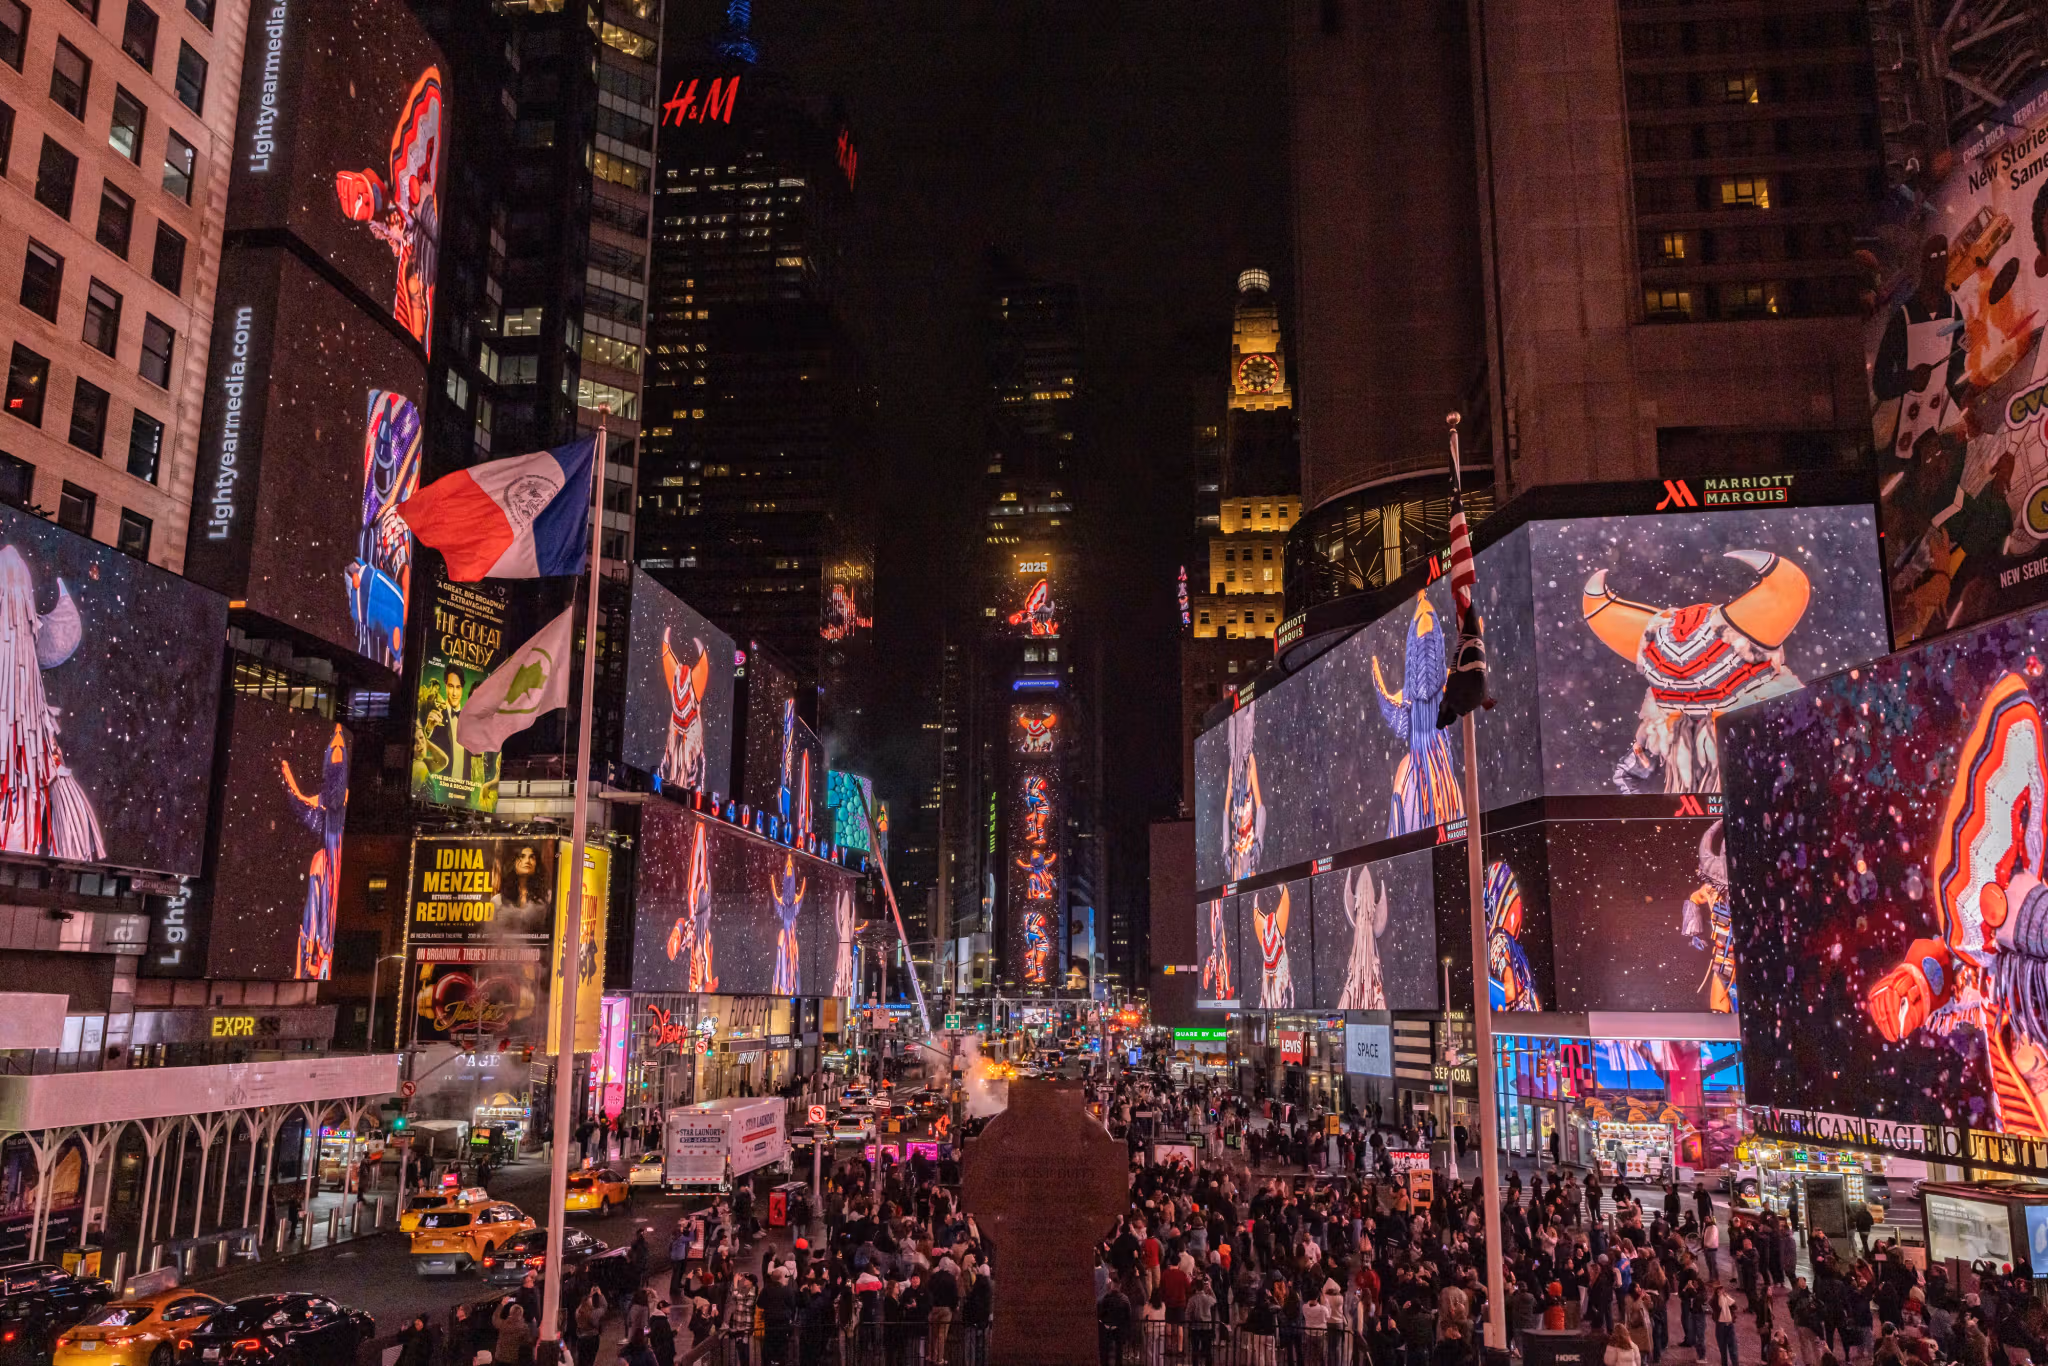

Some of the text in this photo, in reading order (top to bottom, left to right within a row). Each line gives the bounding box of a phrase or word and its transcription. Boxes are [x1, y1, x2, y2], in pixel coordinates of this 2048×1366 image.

[250, 0, 287, 172] Lightyearmedia.
[662, 76, 740, 127] H&M
[1968, 162, 1998, 195] New
[2010, 151, 2048, 190] Same
[208, 307, 253, 539] Lightyearmedia.com
[1705, 475, 1794, 489] MARRIOTT
[1706, 490, 1785, 504] MARQUIS
[1020, 562, 1048, 572] 2025
[2000, 566, 2020, 588] NEW
[450, 593, 494, 615] EXTRAVAGANZA
[464, 590, 475, 600] BIG
[475, 594, 506, 611] BROADWAY
[435, 610, 503, 649] THE GREAT
[1278, 613, 1307, 636] MARRIOTT
[1278, 627, 1303, 648] MARQUIS
[441, 635, 494, 667] GATSBY
[695, 787, 750, 829] 1540
[436, 849, 484, 869] IDINA
[423, 871, 493, 892] MENZEL
[416, 901, 495, 922] REDWOOD
[416, 948, 425, 961] ON
[426, 948, 461, 962] BROADWAY,
[463, 948, 486, 961] THERE'S
[1444, 1012, 1464, 1020] SPHORA
[1357, 1042, 1379, 1058] SPACE
[1761, 1106, 1863, 1143] AMERICAN
[1865, 1121, 1939, 1155] EAGLE
